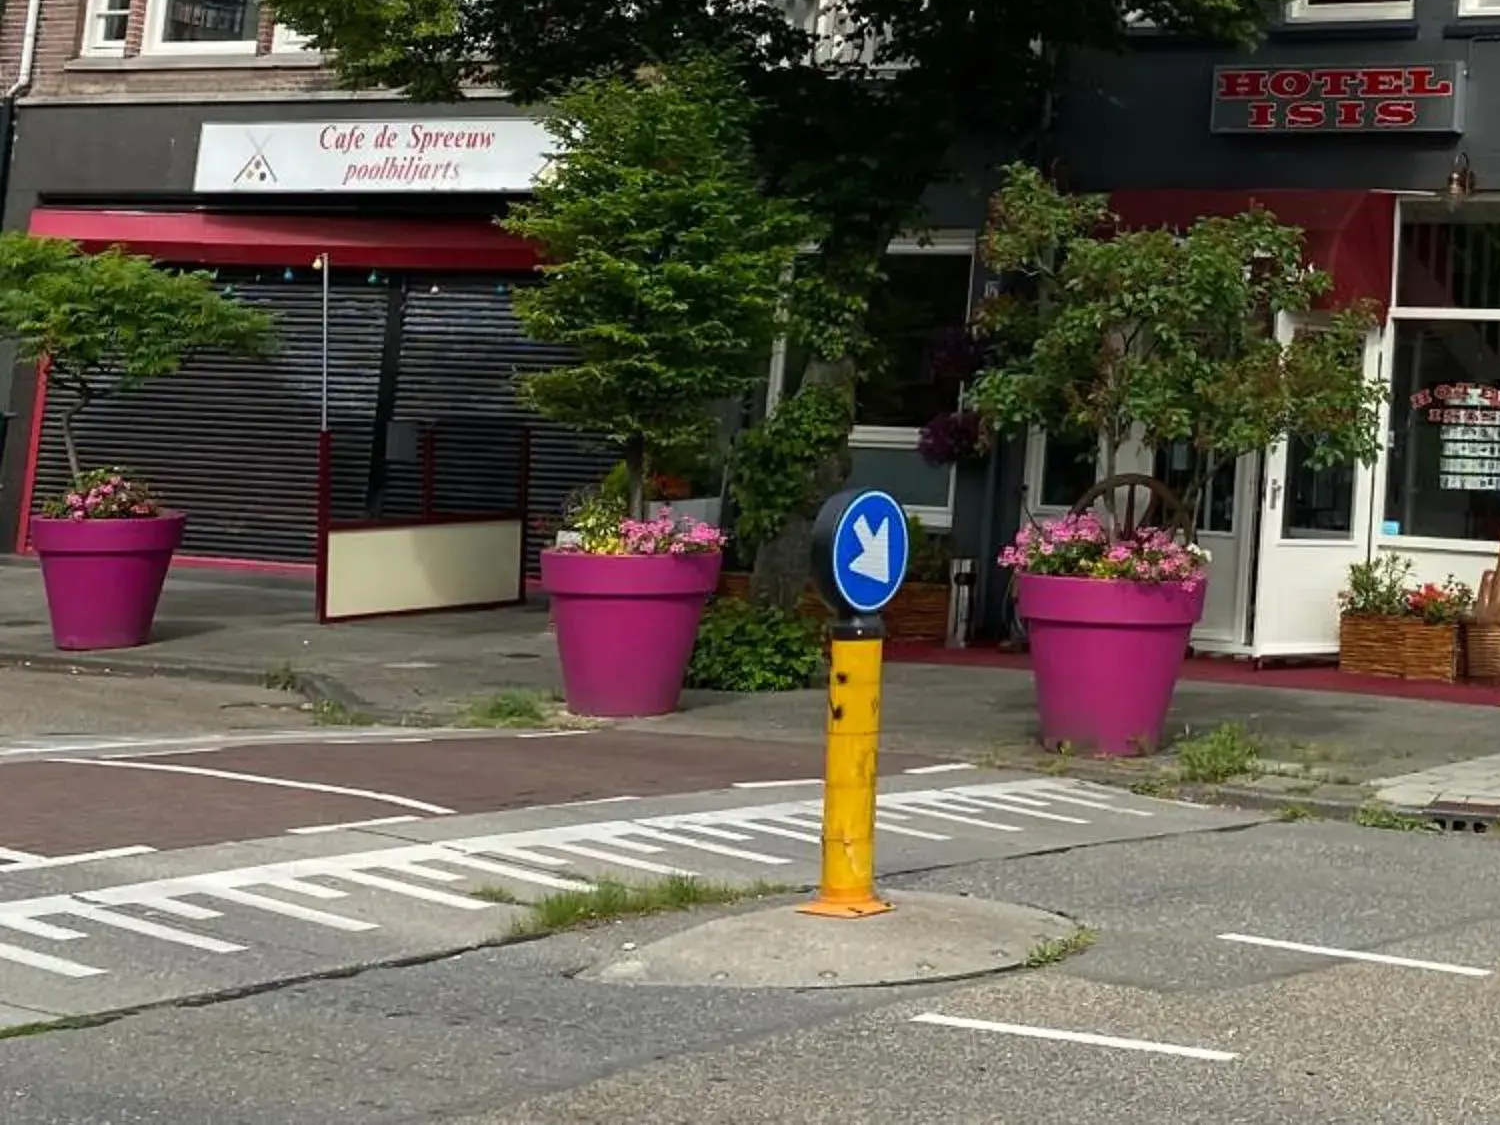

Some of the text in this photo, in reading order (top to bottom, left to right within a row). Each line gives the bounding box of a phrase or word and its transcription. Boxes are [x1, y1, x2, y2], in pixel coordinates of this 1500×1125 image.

[1218, 68, 1454, 99] HOTEL
[1248, 101, 1417, 128] ISIS
[318, 123, 496, 155] Cafe de Spreeuw
[341, 155, 462, 186] poolbiljarts
